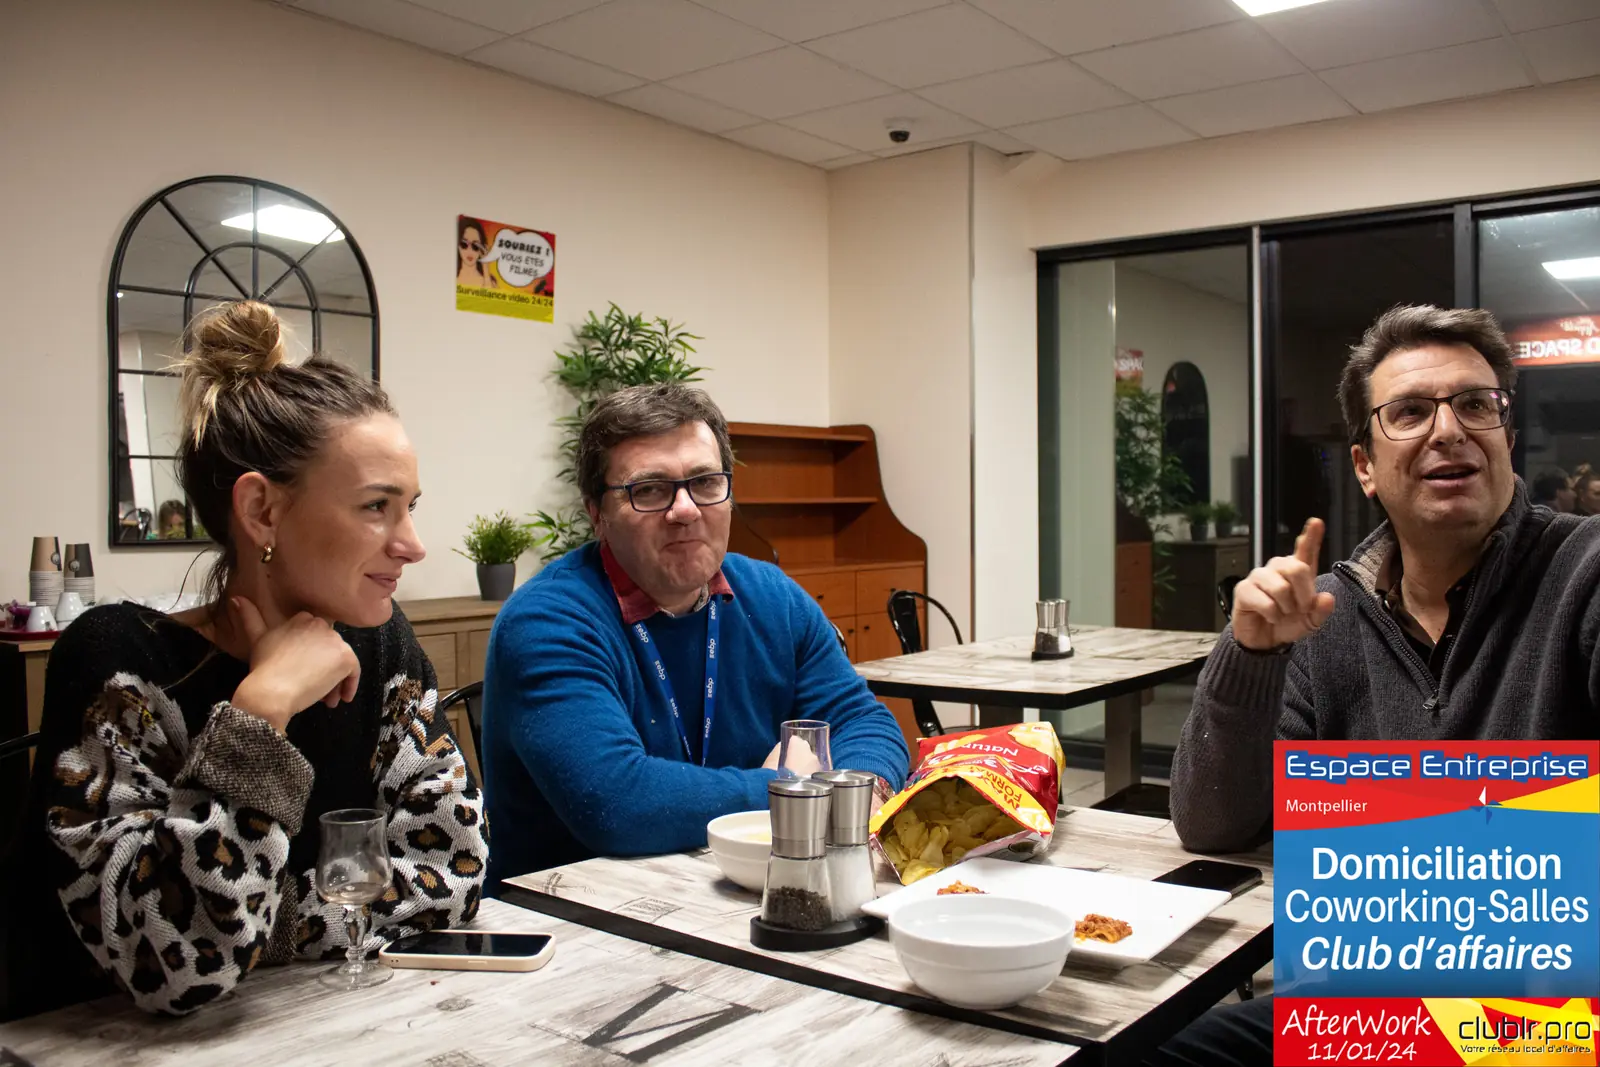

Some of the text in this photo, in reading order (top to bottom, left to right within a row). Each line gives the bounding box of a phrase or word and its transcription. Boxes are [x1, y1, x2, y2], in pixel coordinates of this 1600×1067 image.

[498, 239, 542, 254] SOURIEZ
[501, 252, 522, 263] VOUS
[457, 285, 507, 300] Surveillance
